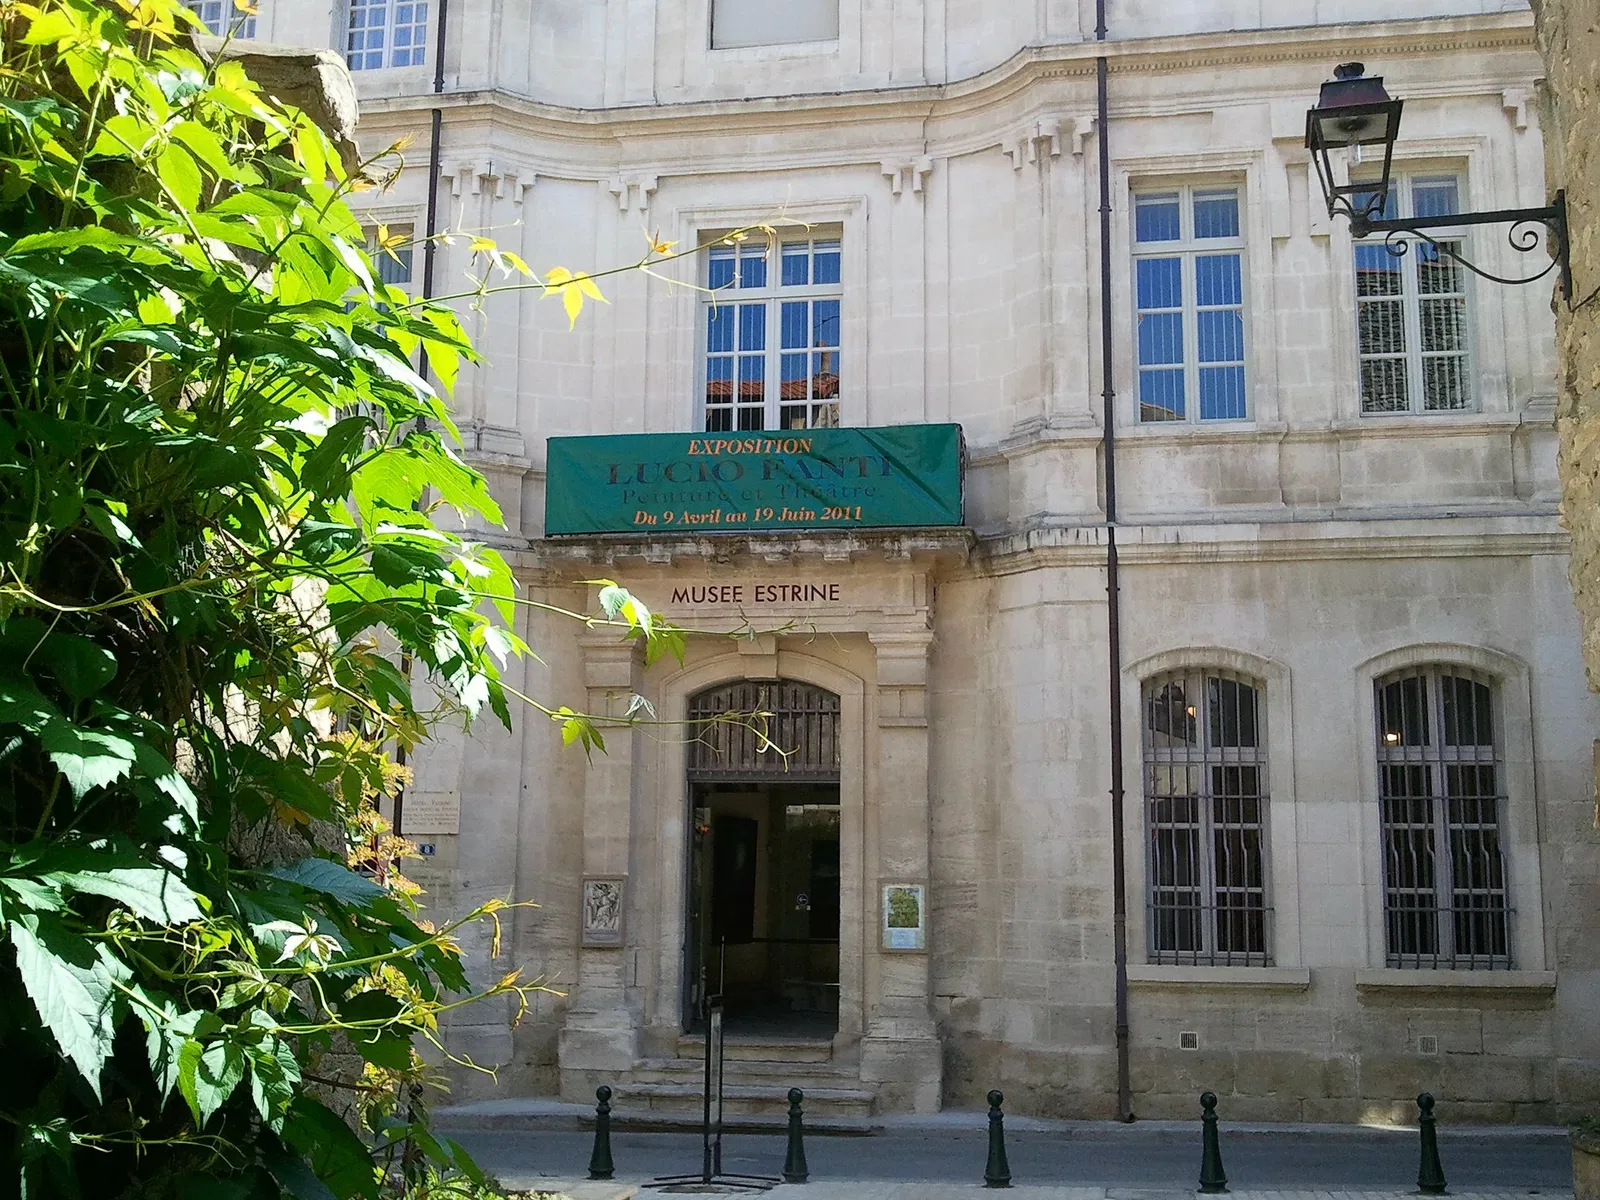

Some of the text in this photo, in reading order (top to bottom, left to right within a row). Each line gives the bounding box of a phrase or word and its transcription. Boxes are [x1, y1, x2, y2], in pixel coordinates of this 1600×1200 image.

[688, 438, 813, 455] EXPOSITION
[606, 455, 894, 485] LUCIO FANTI
[623, 483, 876, 504] Peinture et Théâtre
[633, 505, 863, 525] Du 9 Avril au 19 Juin 2011
[671, 584, 840, 604] MUSEE ESTRINE
